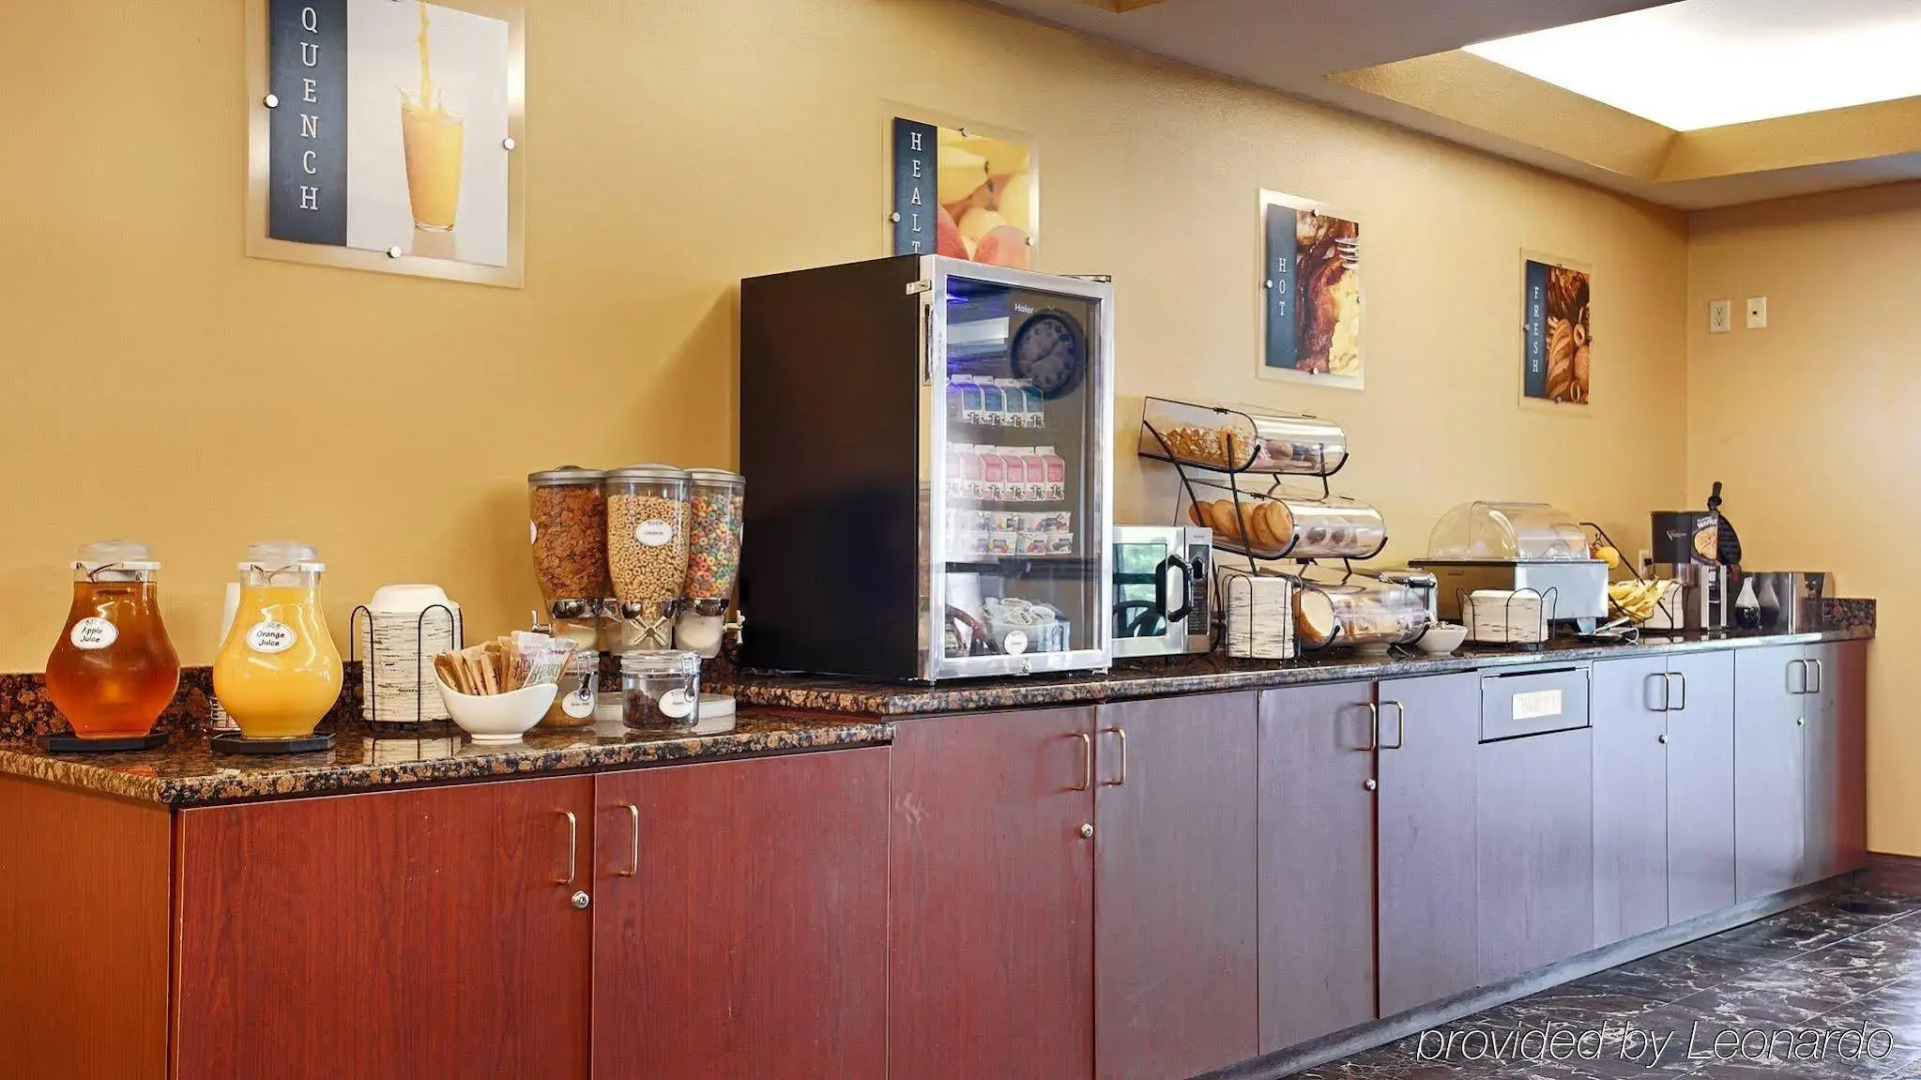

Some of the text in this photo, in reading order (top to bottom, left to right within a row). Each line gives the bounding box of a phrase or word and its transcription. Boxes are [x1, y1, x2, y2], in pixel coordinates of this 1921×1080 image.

[299, 6, 319, 211] QUENCH
[1278, 257, 1287, 316] HOT
[1532, 286, 1540, 373] FRESH
[256, 630, 285, 640] Orange
[258, 639, 280, 647] Juice
